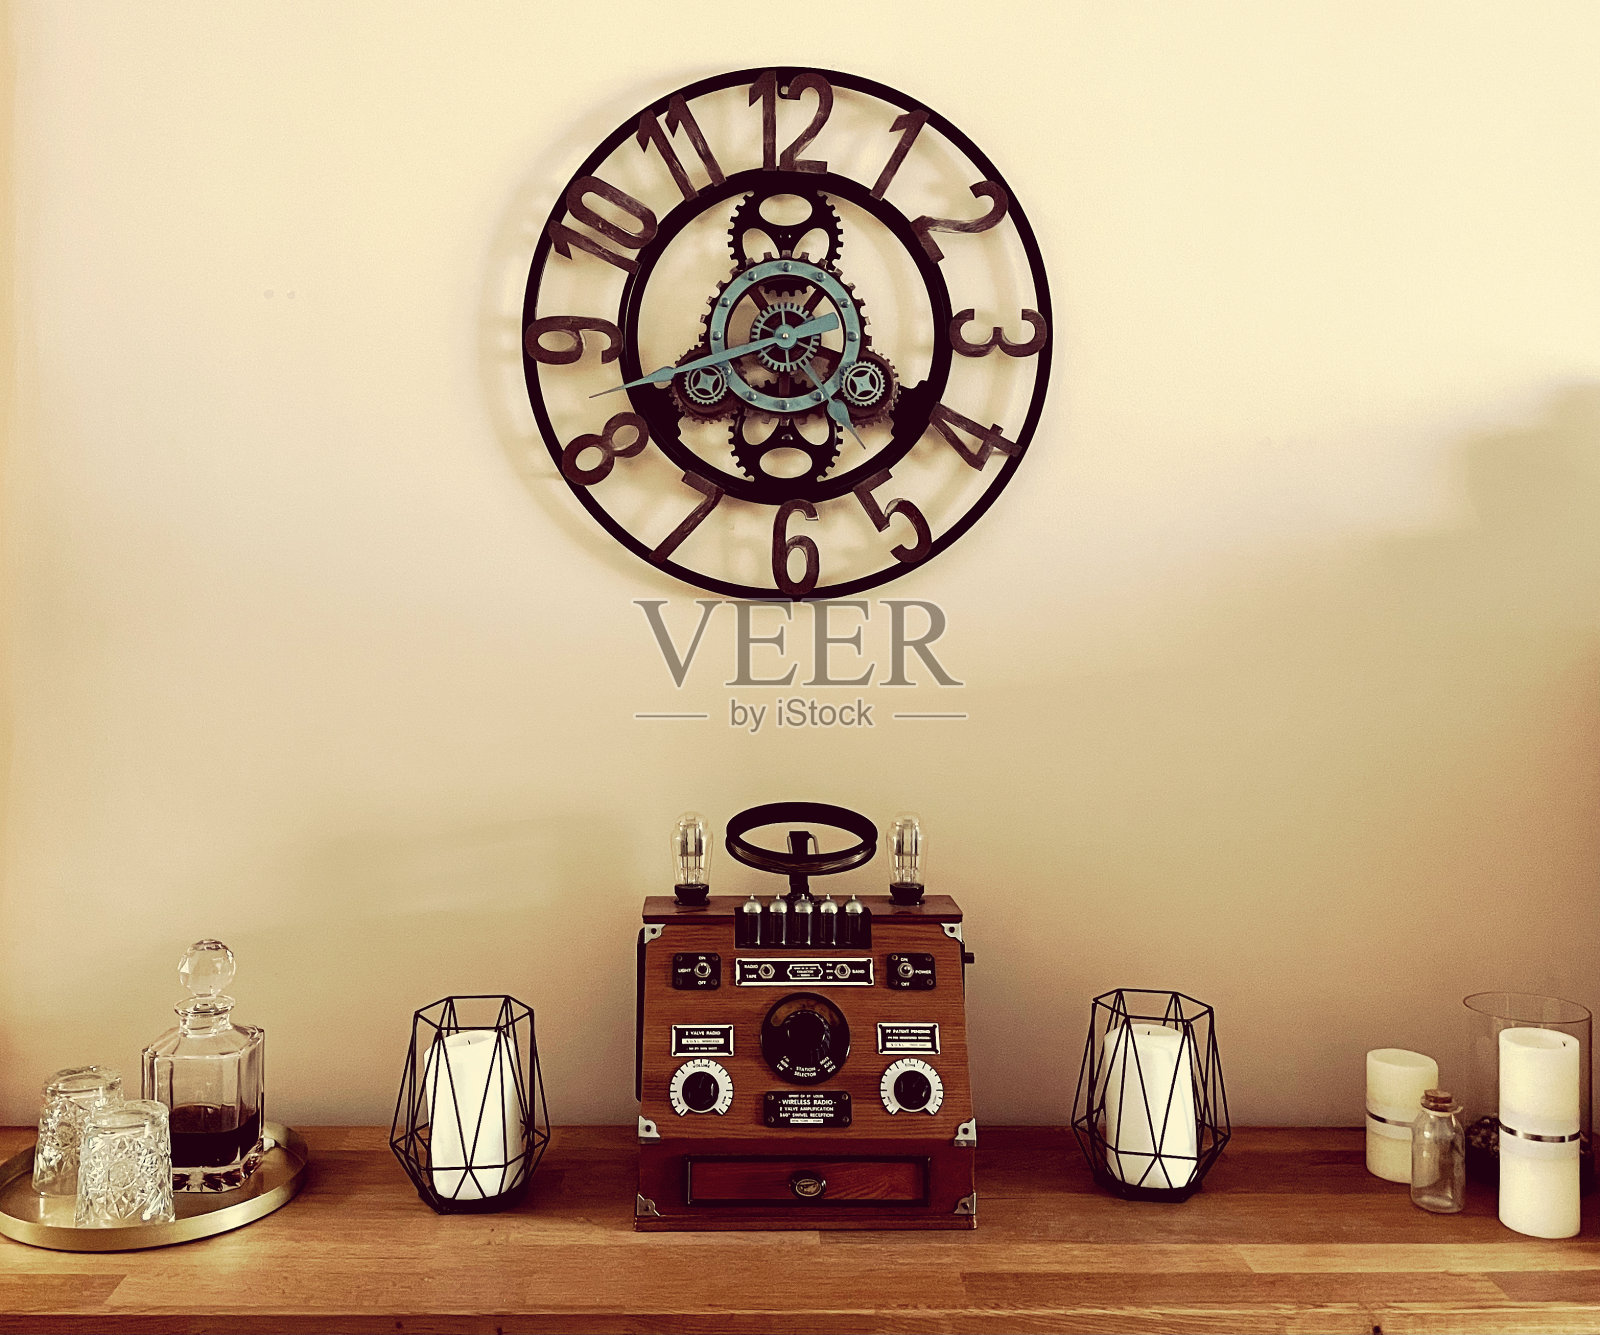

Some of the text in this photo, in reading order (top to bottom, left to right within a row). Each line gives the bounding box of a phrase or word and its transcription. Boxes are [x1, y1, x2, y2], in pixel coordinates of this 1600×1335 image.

[636, 93, 726, 201] 11
[748, 70, 834, 173] 12
[870, 108, 930, 200] 1
[548, 175, 658, 274] 10
[910, 180, 1009, 263] 2
[525, 315, 623, 365] 9
[949, 308, 1048, 358] 3
[561, 411, 649, 486] 8
[928, 401, 1023, 471] 4
[648, 469, 725, 564] 7
[771, 499, 820, 595] 6
[852, 469, 933, 564] 5
